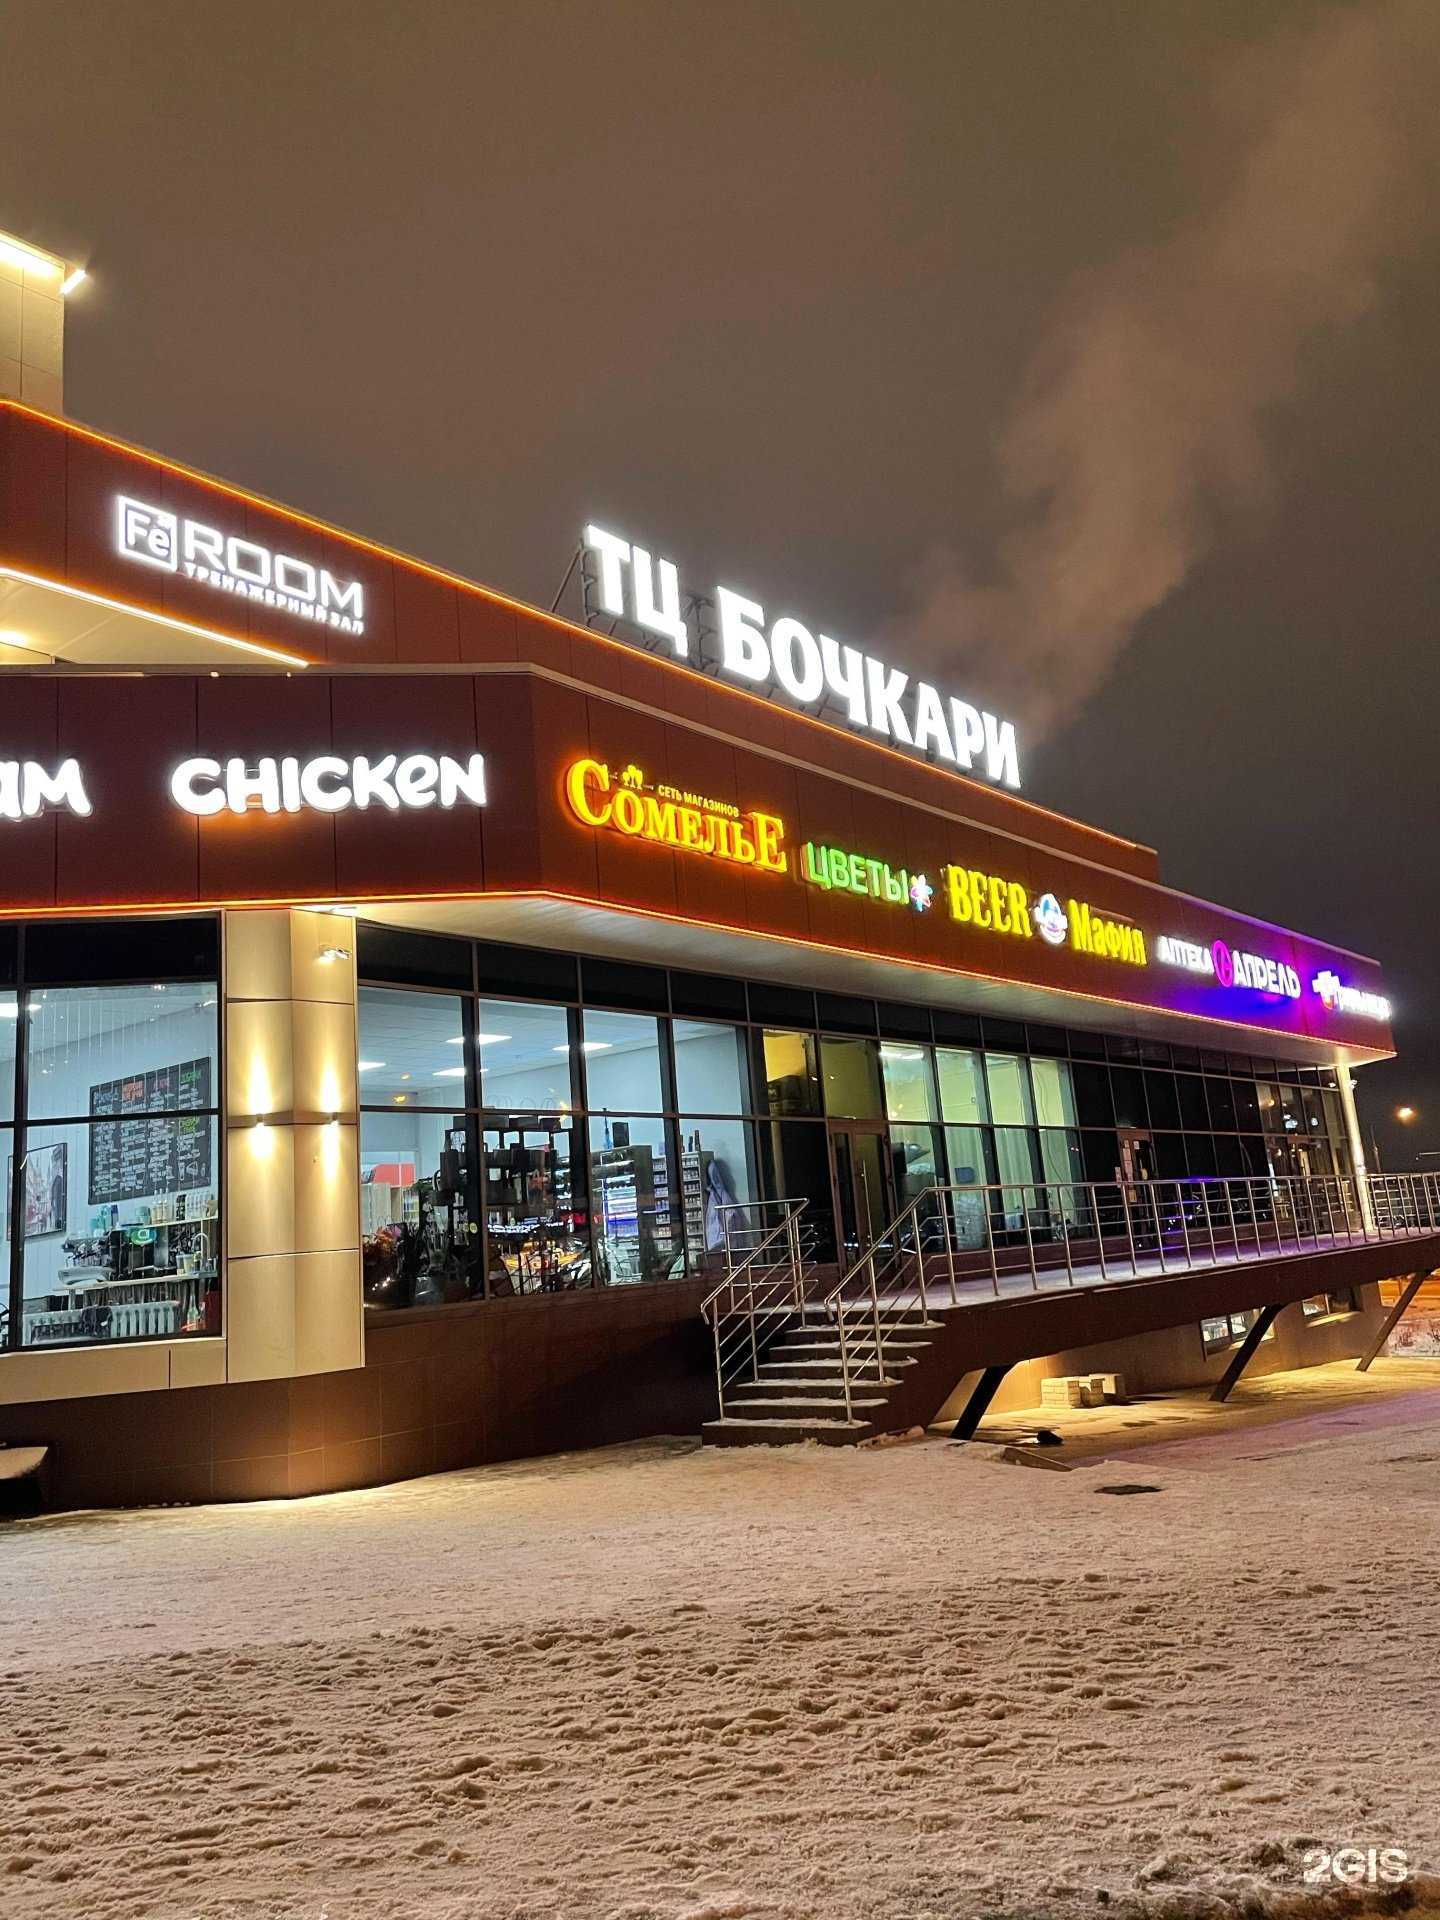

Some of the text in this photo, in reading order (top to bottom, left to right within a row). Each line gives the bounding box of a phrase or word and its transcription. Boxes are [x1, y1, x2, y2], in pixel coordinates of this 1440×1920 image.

[183, 518, 364, 618] ROOM
[330, 612, 364, 636] ЗАЛ
[586, 524, 1021, 789] ТЦ БОЧКАРИ
[567, 758, 788, 873] СОМЕЛЬЕ
[658, 784, 740, 818] СЕТЬ МАГАЗИНОВ
[802, 841, 910, 905] ЦВЕТЫ
[948, 864, 1147, 966] BEER Мафия
[1156, 935, 1215, 976] АПТЕКА
